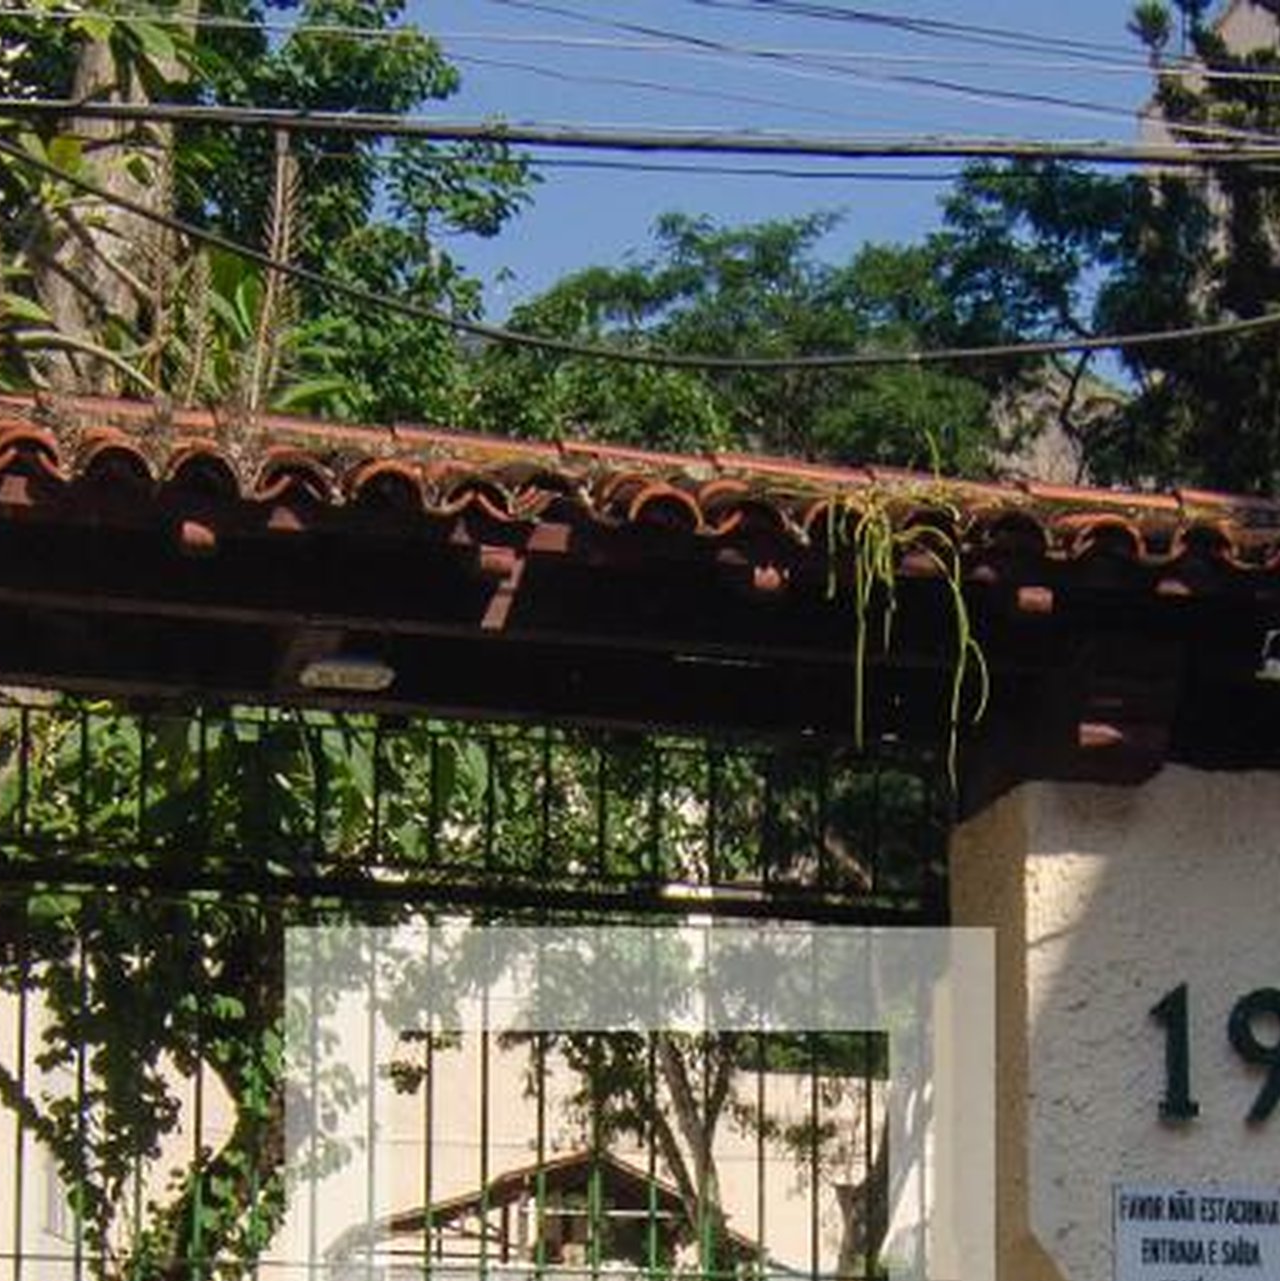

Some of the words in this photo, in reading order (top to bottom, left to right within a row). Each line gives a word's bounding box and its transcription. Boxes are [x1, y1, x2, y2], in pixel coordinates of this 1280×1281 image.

[1121, 1195, 1165, 1220] FAVOR
[1169, 1190, 1195, 1221] NÃO
[1142, 1238, 1204, 1265] ENTRADA
[1208, 1240, 1217, 1266] E
[1222, 1235, 1261, 1267] SAÍDA
